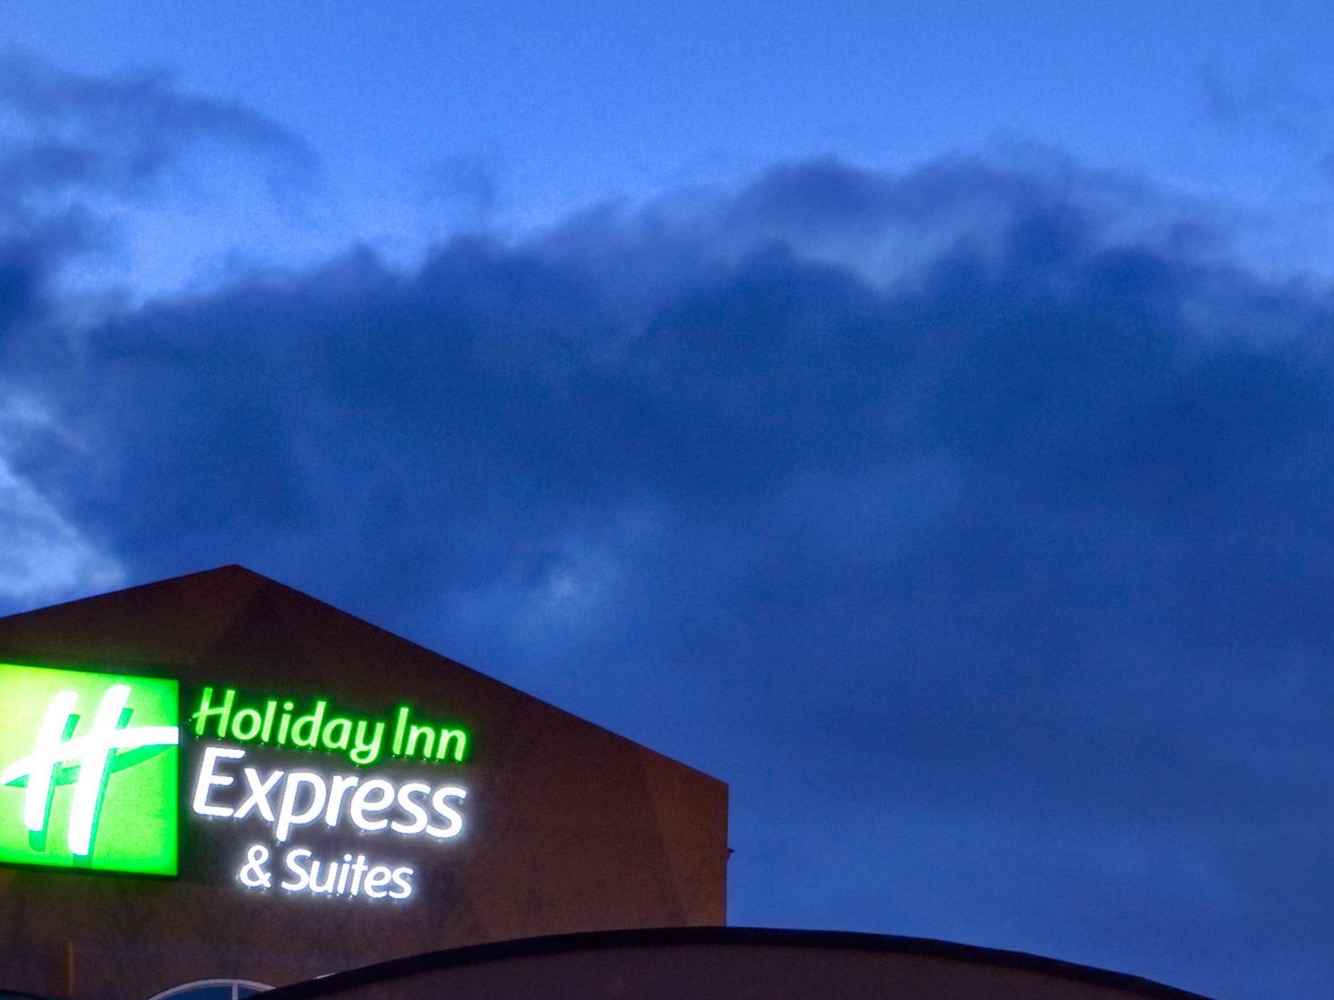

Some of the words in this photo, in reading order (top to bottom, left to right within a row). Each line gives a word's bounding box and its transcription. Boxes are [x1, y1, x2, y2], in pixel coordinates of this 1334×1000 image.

[192, 686, 385, 768] Holiday
[388, 706, 468, 763] Inn
[192, 746, 467, 842] Express
[237, 842, 273, 889] &
[281, 848, 414, 901] Suites
